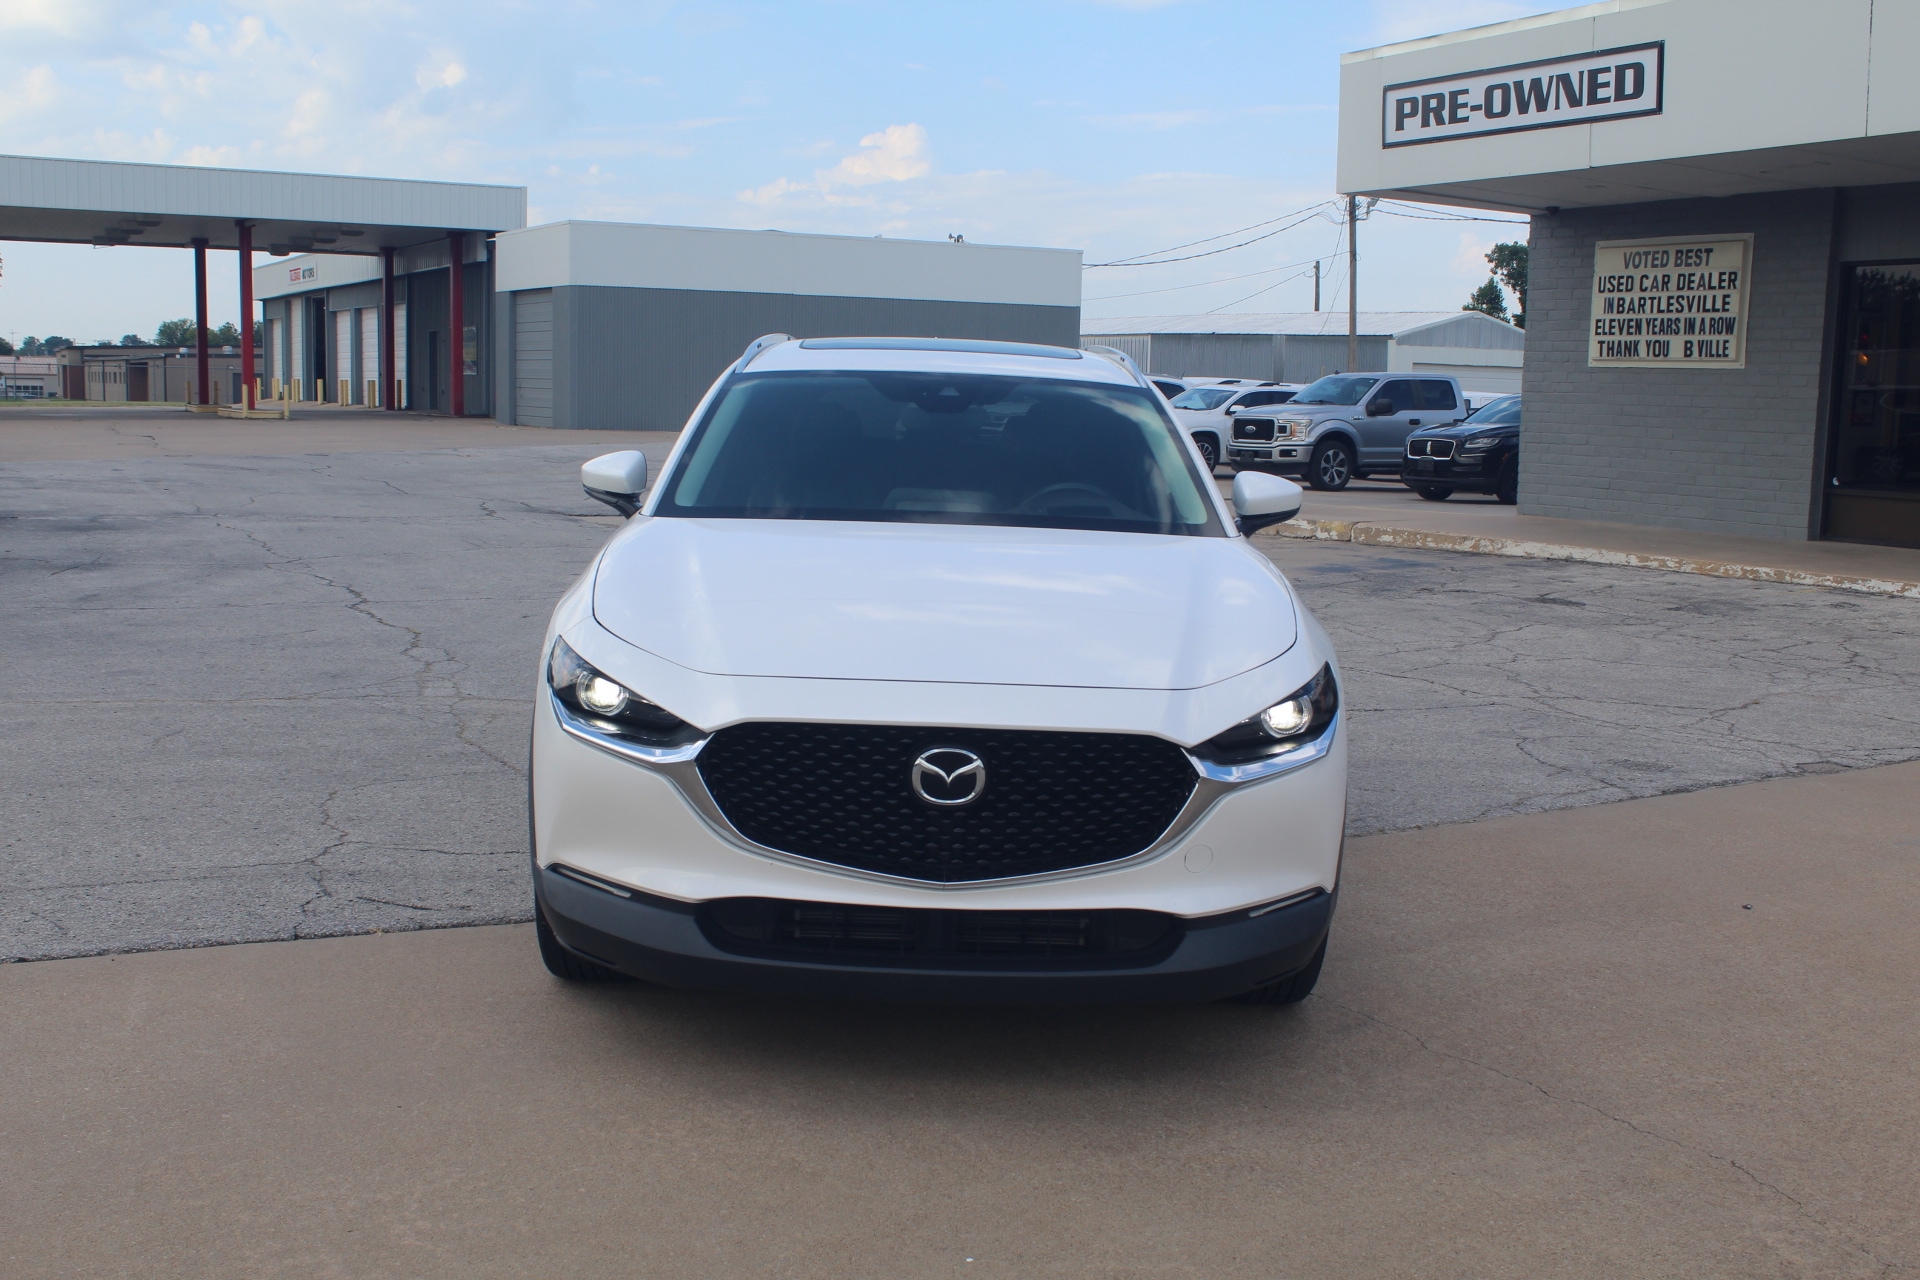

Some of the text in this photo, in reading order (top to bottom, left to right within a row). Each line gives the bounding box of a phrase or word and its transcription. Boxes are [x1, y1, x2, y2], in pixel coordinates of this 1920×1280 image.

[1395, 61, 1645, 132] PRE-OWNED
[1623, 248, 1713, 269] VOTED BEST
[1598, 271, 1738, 293] USED CAR DEALER
[1616, 294, 1731, 314] BARTLESVILLE
[1595, 316, 1736, 336] ELEVEN YEARS IN A ROW
[1597, 339, 1730, 358] THANK YOU B VILLE
